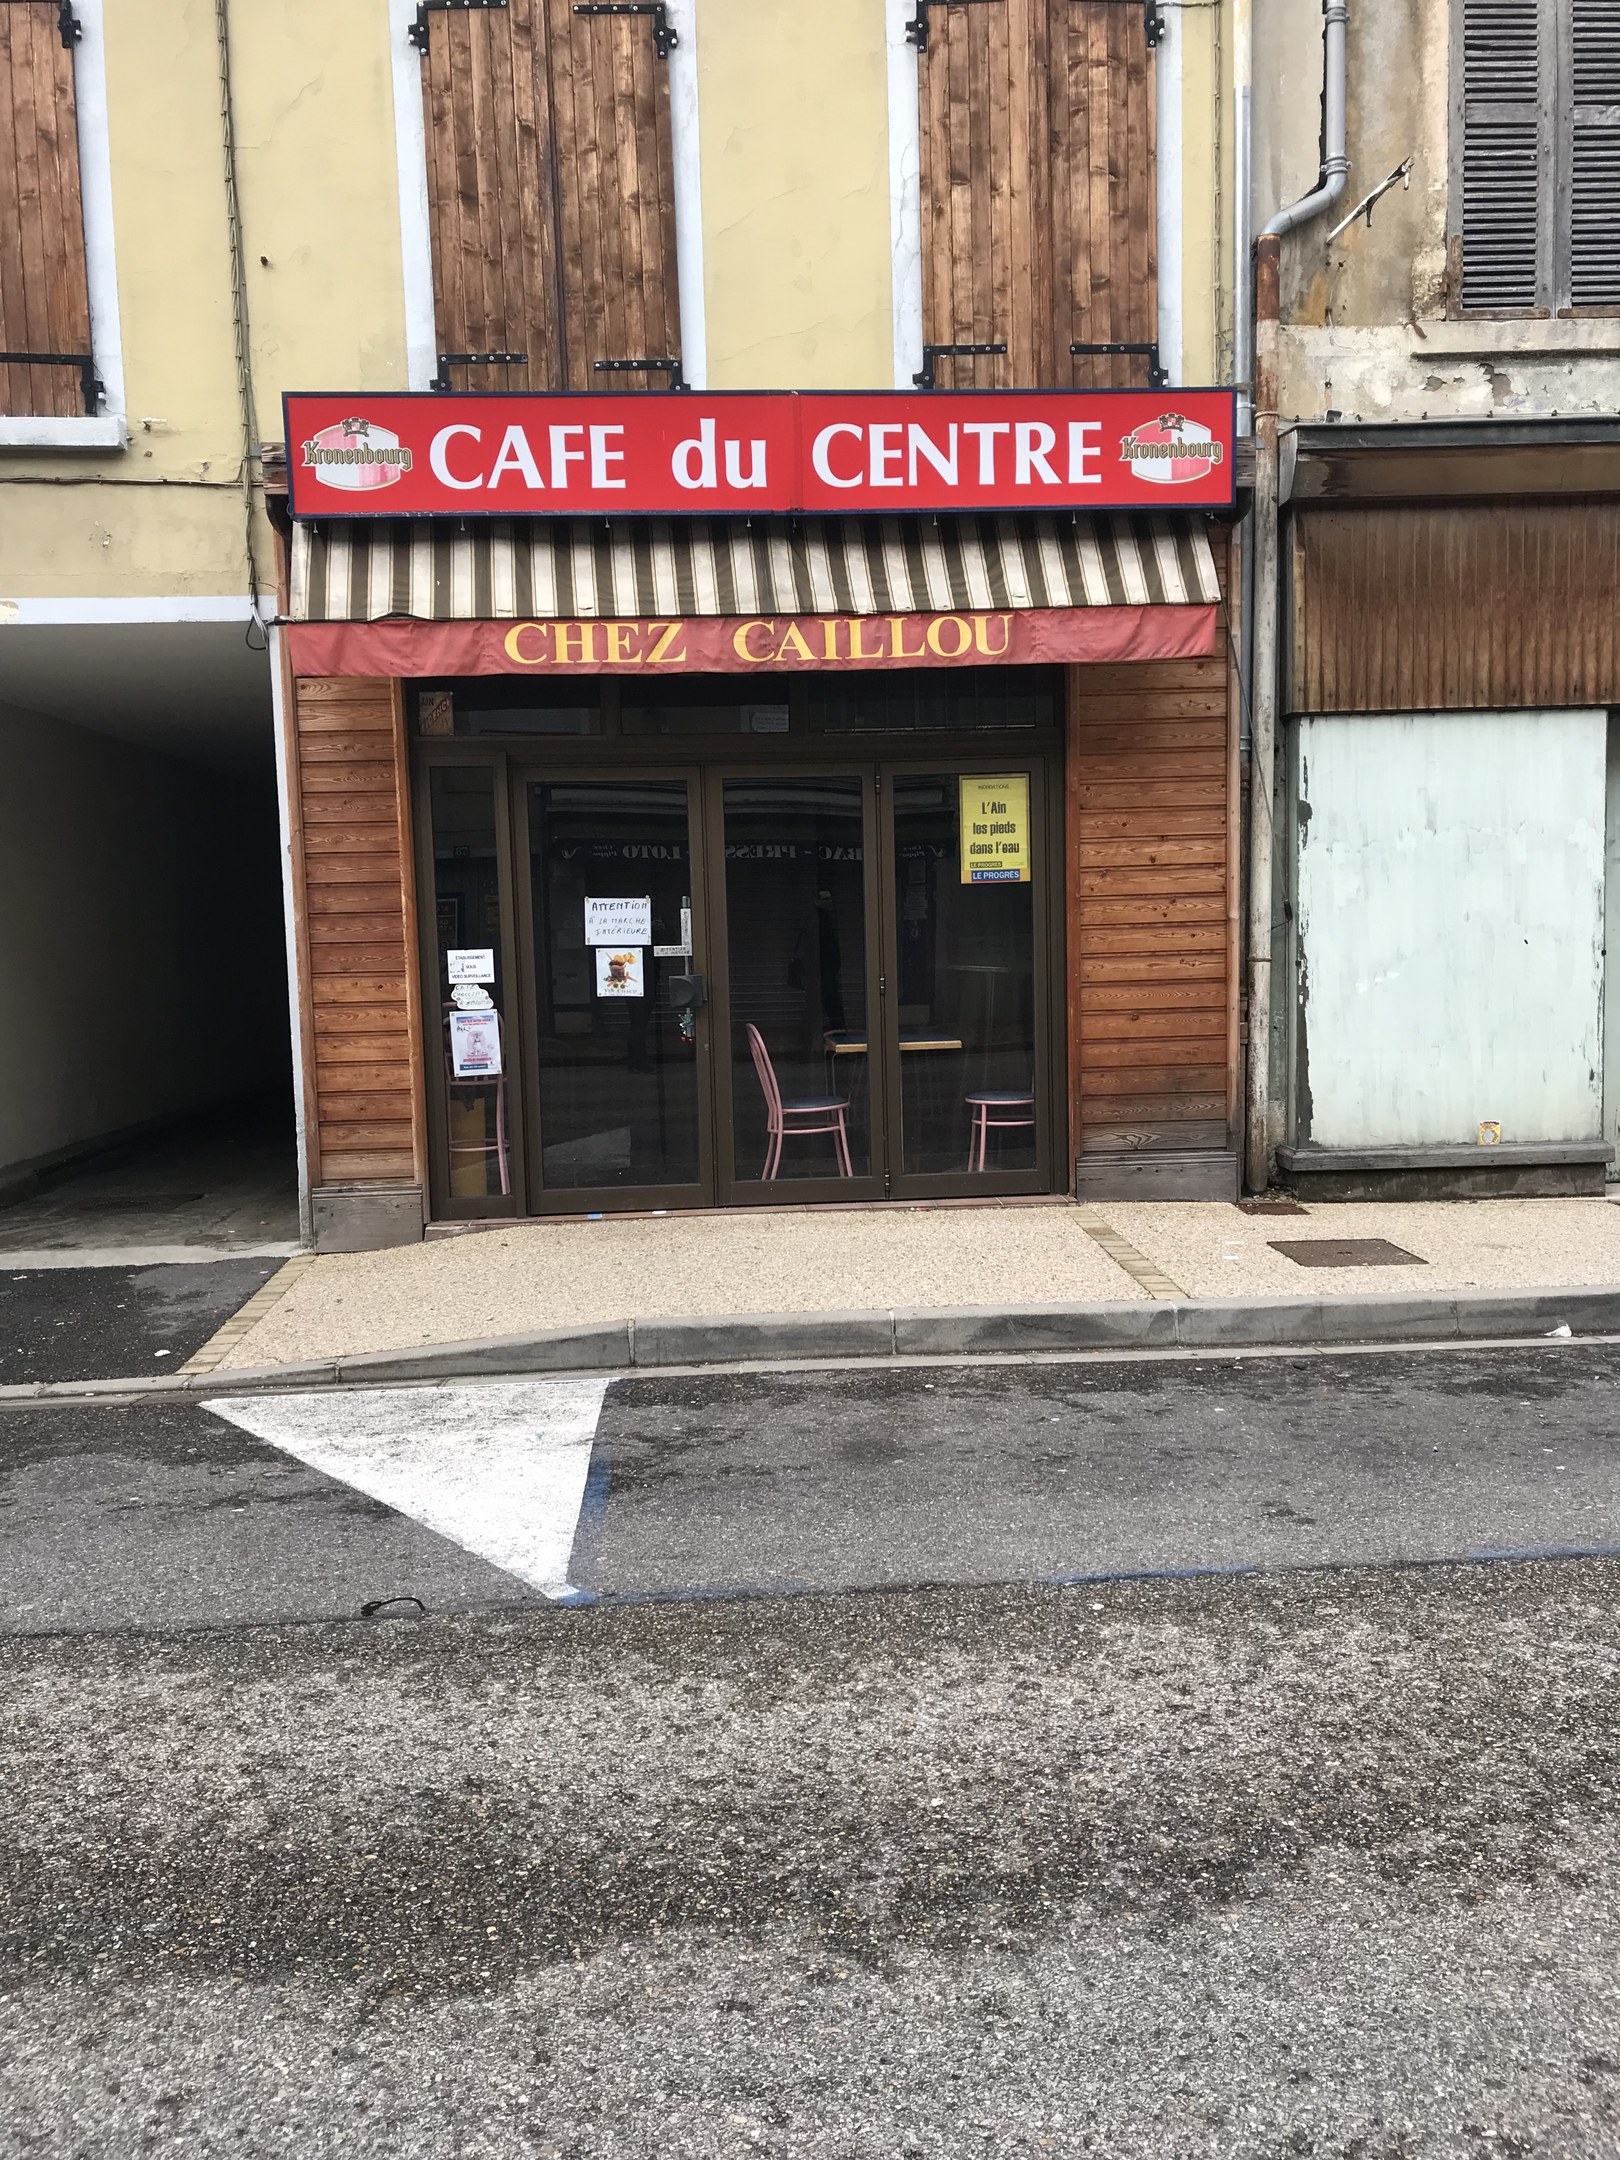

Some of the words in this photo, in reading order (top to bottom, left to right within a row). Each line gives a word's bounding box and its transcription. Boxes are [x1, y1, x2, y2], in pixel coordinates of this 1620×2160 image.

[301, 440, 412, 472] Kronenbourg
[429, 424, 627, 489] CAFE
[671, 418, 768, 489] du
[812, 421, 1102, 488] CENTRE
[1119, 436, 1223, 465] Kronenbourg
[503, 622, 688, 665] CHEZ
[732, 614, 1014, 663] CAILLOU
[981, 801, 1006, 814] L'Ain
[973, 822, 988, 834] les
[990, 821, 1016, 836] pieds
[970, 842, 993, 854] dans
[996, 841, 1020, 854] l'eau
[972, 872, 982, 880] LE
[611, 917, 646, 925] MARCHE
